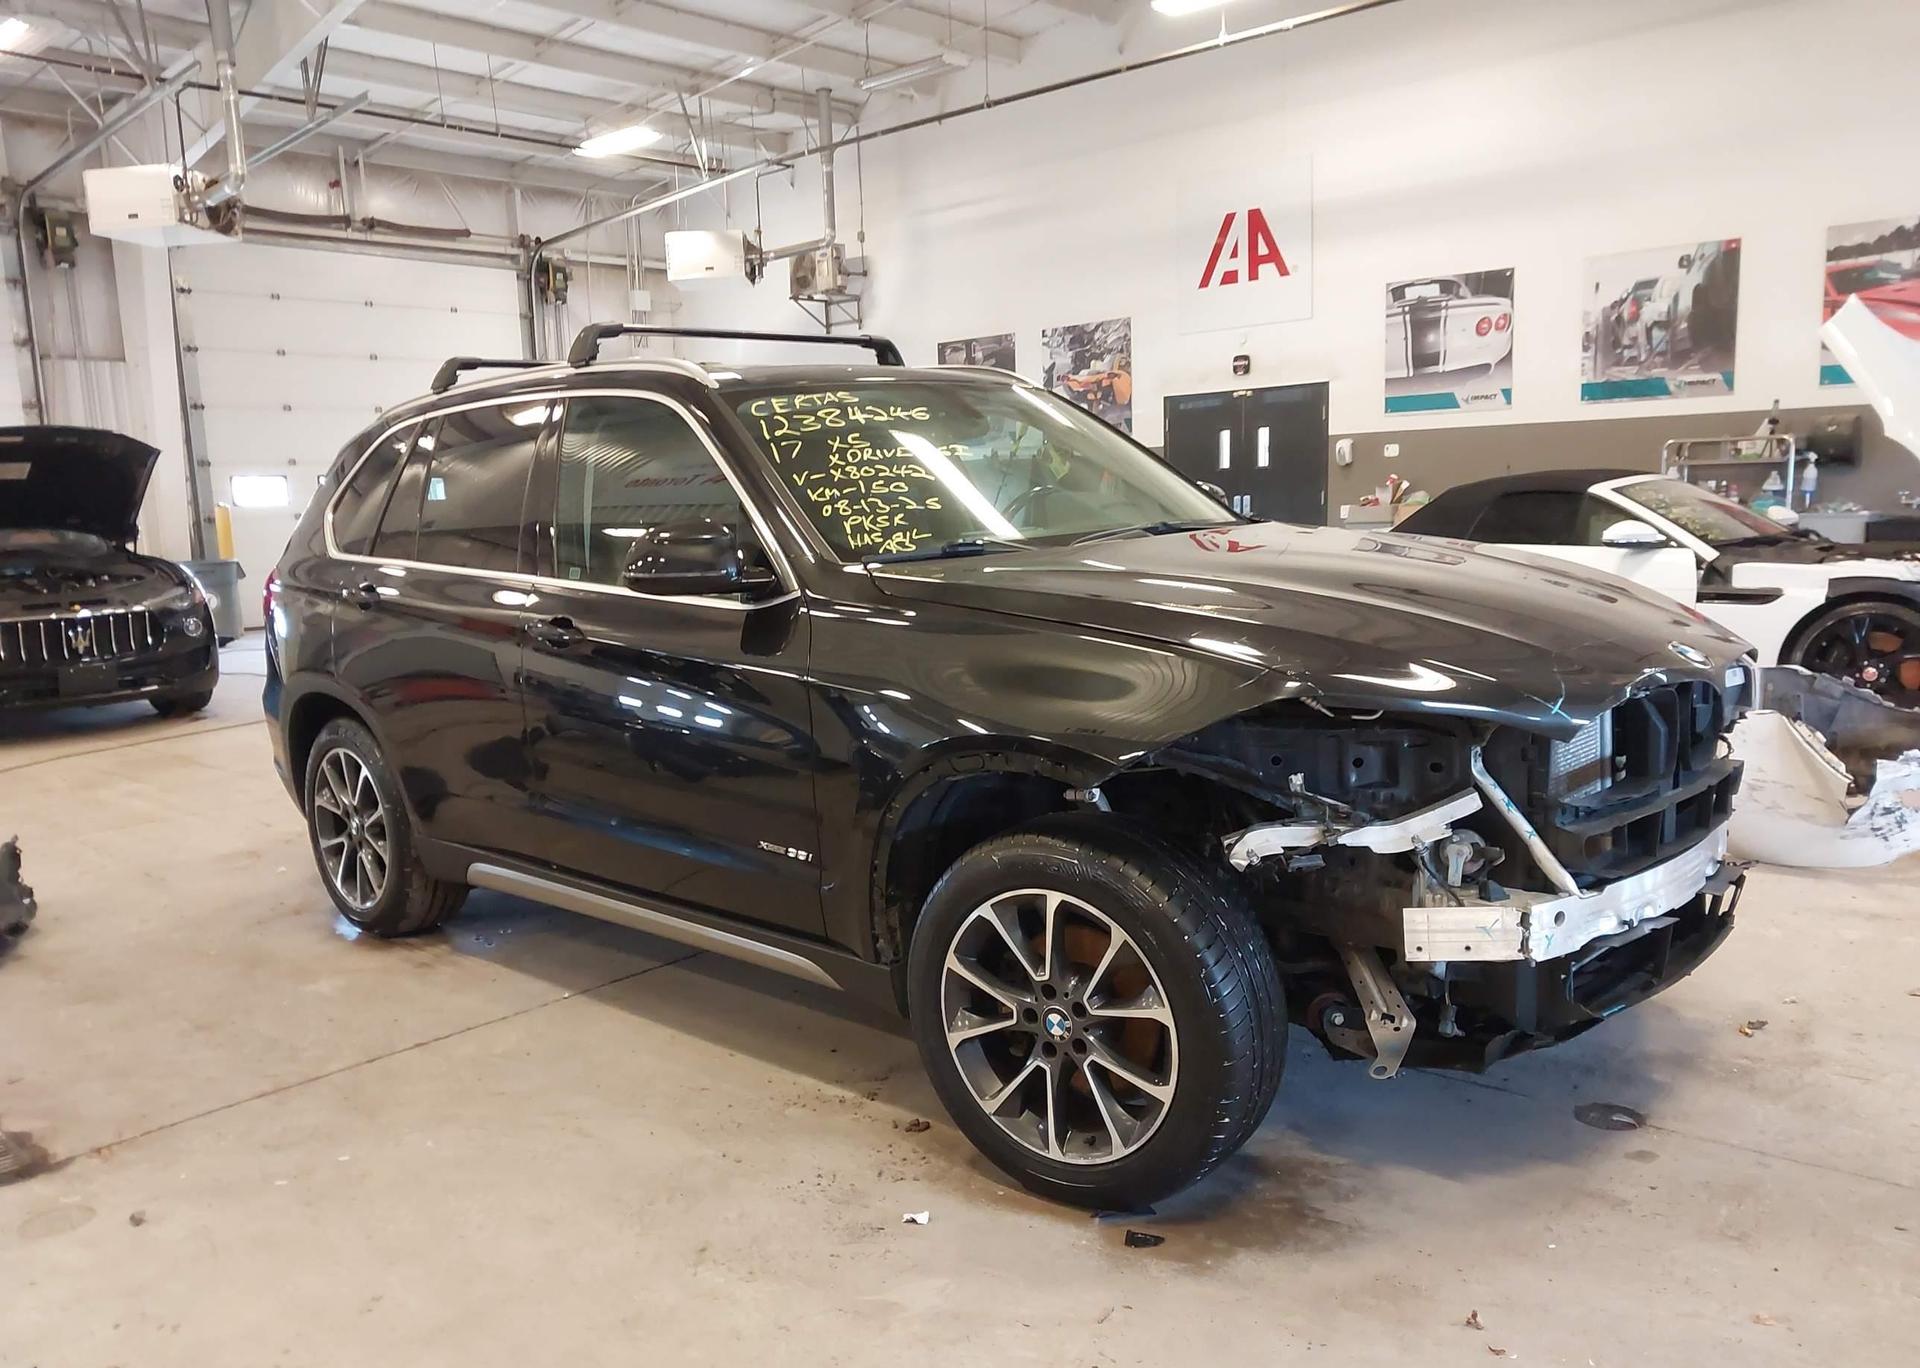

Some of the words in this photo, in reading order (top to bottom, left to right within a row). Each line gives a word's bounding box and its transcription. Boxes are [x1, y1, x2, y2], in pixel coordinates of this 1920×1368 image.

[751, 391, 860, 417] CERTAS
[1470, 393, 1498, 401] IMPACT
[760, 406, 930, 440] 12384246
[770, 440, 802, 464] 17
